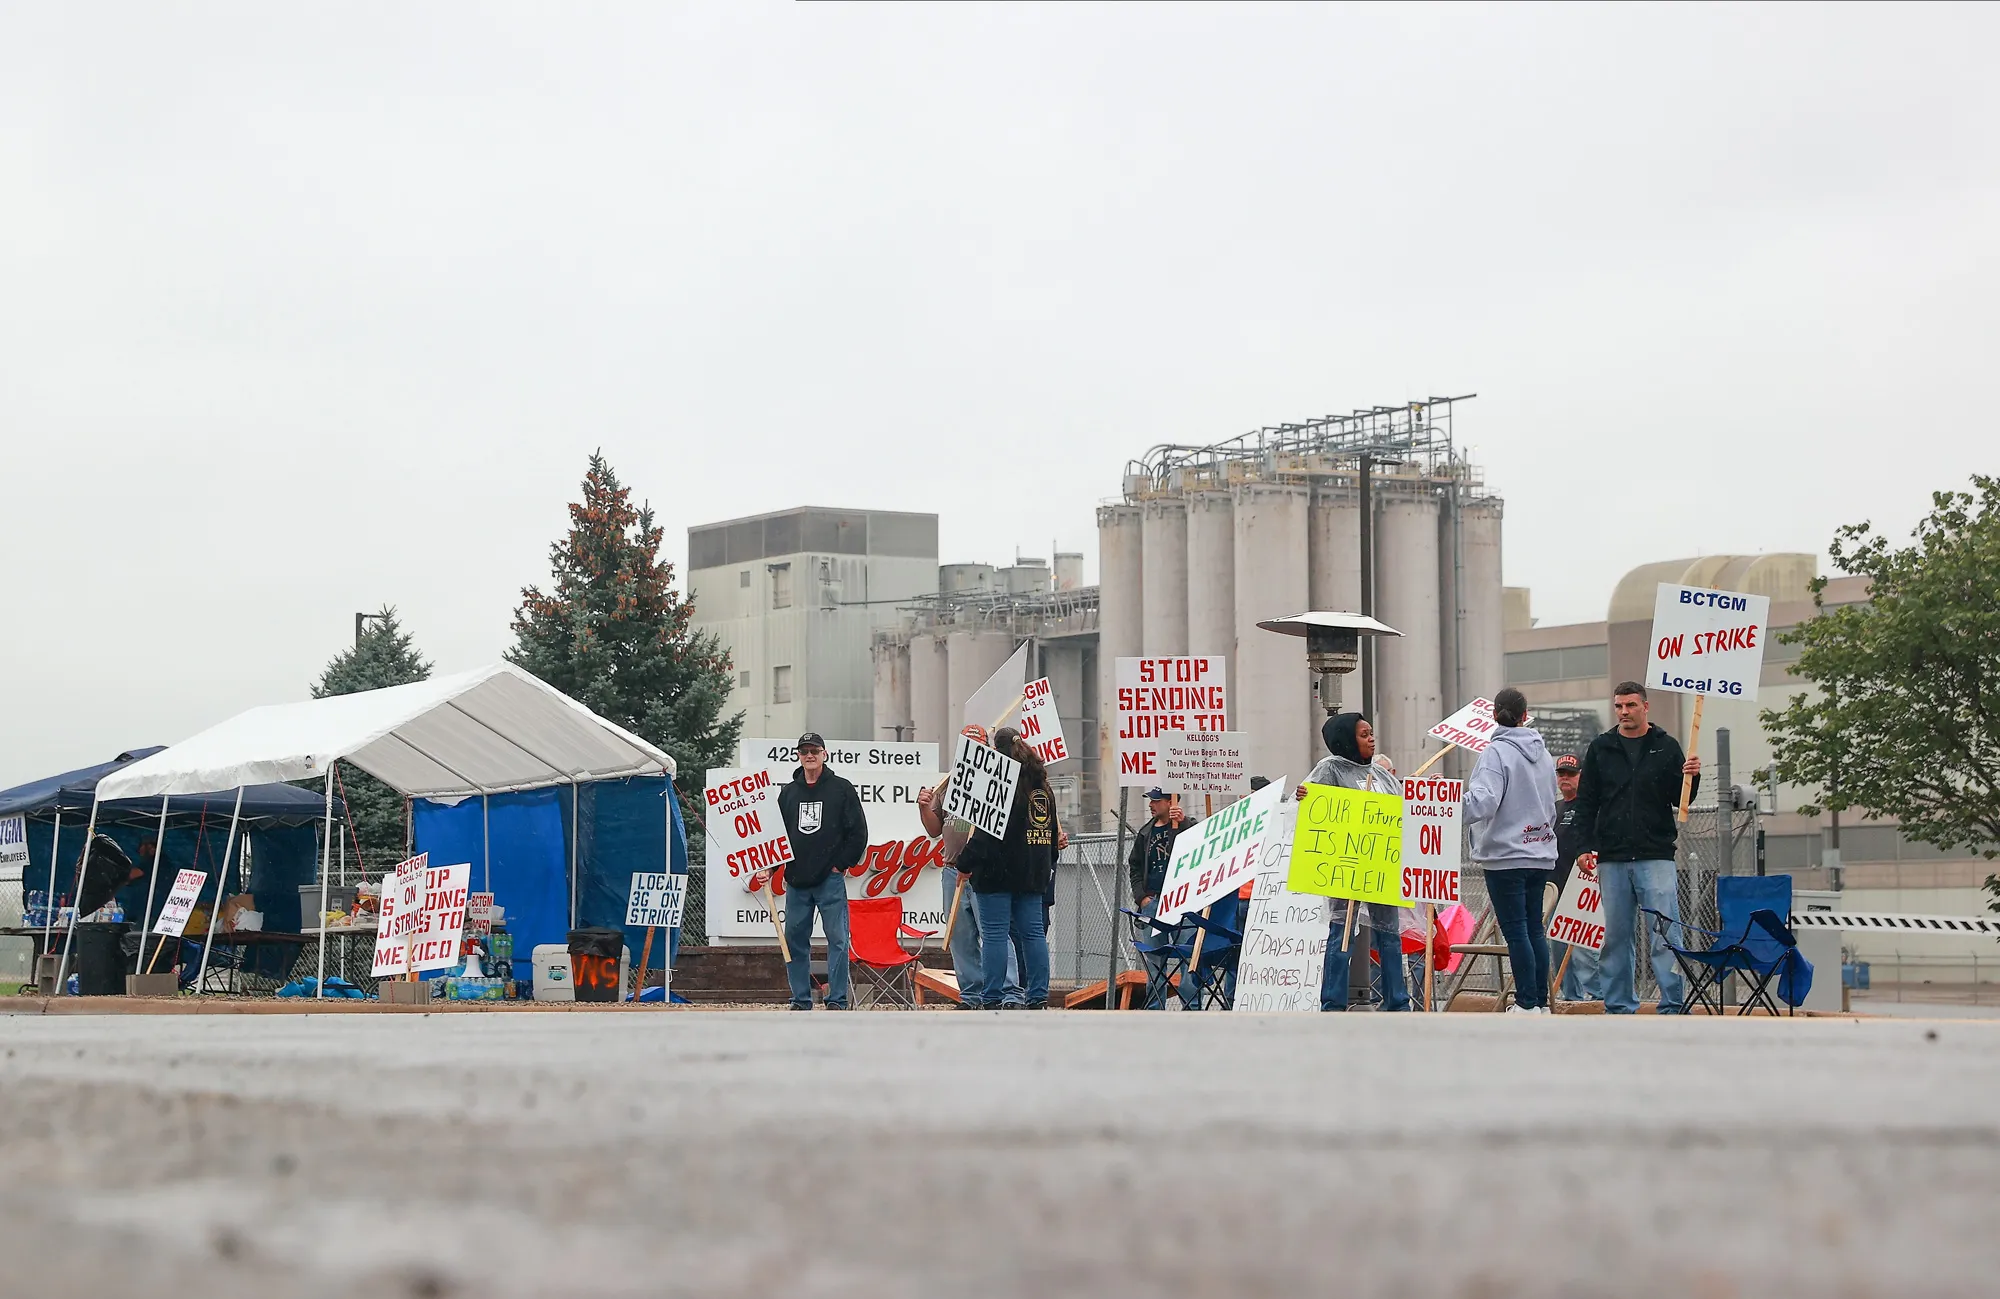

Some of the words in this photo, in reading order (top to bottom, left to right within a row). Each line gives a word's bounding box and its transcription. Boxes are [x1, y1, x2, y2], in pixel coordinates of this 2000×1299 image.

[1680, 590, 1746, 611] BCTGM
[1658, 633, 1684, 660] ON
[1691, 625, 1758, 655] STRIKE
[1140, 659, 1208, 682] STOP
[1662, 672, 1712, 691] Local
[1717, 680, 1742, 695] 3G
[1031, 698, 1045, 709] 3-G
[1119, 687, 1223, 710] SENDING
[1472, 699, 1495, 711] BC
[1194, 714, 1225, 731] TO
[1471, 708, 1495, 719] LOCA
[1020, 714, 1041, 739] ON
[1466, 717, 1495, 733] ON
[1186, 734, 1220, 742] KELLOGG'S
[1432, 723, 1492, 752] STRIKE
[823, 750, 861, 764] orter
[868, 749, 921, 765] Street
[1031, 737, 1066, 762] IKE
[1184, 748, 1199, 756] Lives
[1201, 749, 1217, 757] Begin
[1228, 749, 1239, 757] End
[962, 739, 1012, 785] LOCAL
[1121, 752, 1157, 774] ME
[1179, 760, 1189, 768] Day
[1202, 760, 1224, 768] Become
[953, 762, 975, 792] 3G
[985, 779, 1008, 810] ON
[1167, 771, 1184, 779] About
[1185, 771, 1205, 780] Things
[706, 770, 771, 806] BCTGM
[893, 785, 920, 804] PL
[1208, 784, 1222, 792] King
[1404, 779, 1461, 803] BCTGM
[718, 798, 749, 815] LOCAL
[749, 792, 766, 804] 3-G
[948, 788, 1006, 836] STRIKE
[1308, 795, 1351, 824] OUR
[1362, 800, 1403, 828] Future
[1411, 805, 1437, 817] LOCAL
[1439, 806, 1453, 818] 3-G
[734, 810, 762, 838] ON
[1204, 797, 1251, 839] OUR
[0, 817, 23, 845] TGM
[1420, 824, 1441, 855] ON
[1173, 809, 1268, 879] FUTURE
[1304, 829, 1336, 856] IS
[1344, 832, 1383, 861] NOT
[1384, 836, 1400, 863] FO
[396, 854, 426, 878] BCTGM
[726, 836, 792, 878] STRIKE
[176, 872, 204, 886] BCTGM
[400, 875, 415, 885] LOCAL
[415, 870, 423, 880] 3-G
[425, 868, 450, 889] OP
[637, 874, 682, 891] LOCAL
[1402, 866, 1459, 901] STRIKE
[1577, 871, 1600, 884] LOCA
[168, 896, 191, 908] HONK
[404, 884, 417, 906] ON
[471, 895, 493, 907] BCTGM
[631, 891, 650, 907] 3G
[660, 892, 680, 908] ON
[1158, 882, 1190, 917] NO
[1577, 887, 1601, 913] ON
[394, 907, 424, 936] STRIKE
[439, 911, 463, 931] TO
[630, 908, 680, 925] STRIKE
[736, 910, 786, 923] EMPLO
[902, 911, 947, 924] TRANC
[1286, 905, 1321, 924] MOS
[1550, 914, 1605, 949] STRIKE
[374, 940, 452, 967] MEXICO
[1295, 938, 1305, 957] A
[1309, 938, 1327, 955] WE
[1302, 991, 1320, 1012] SA
